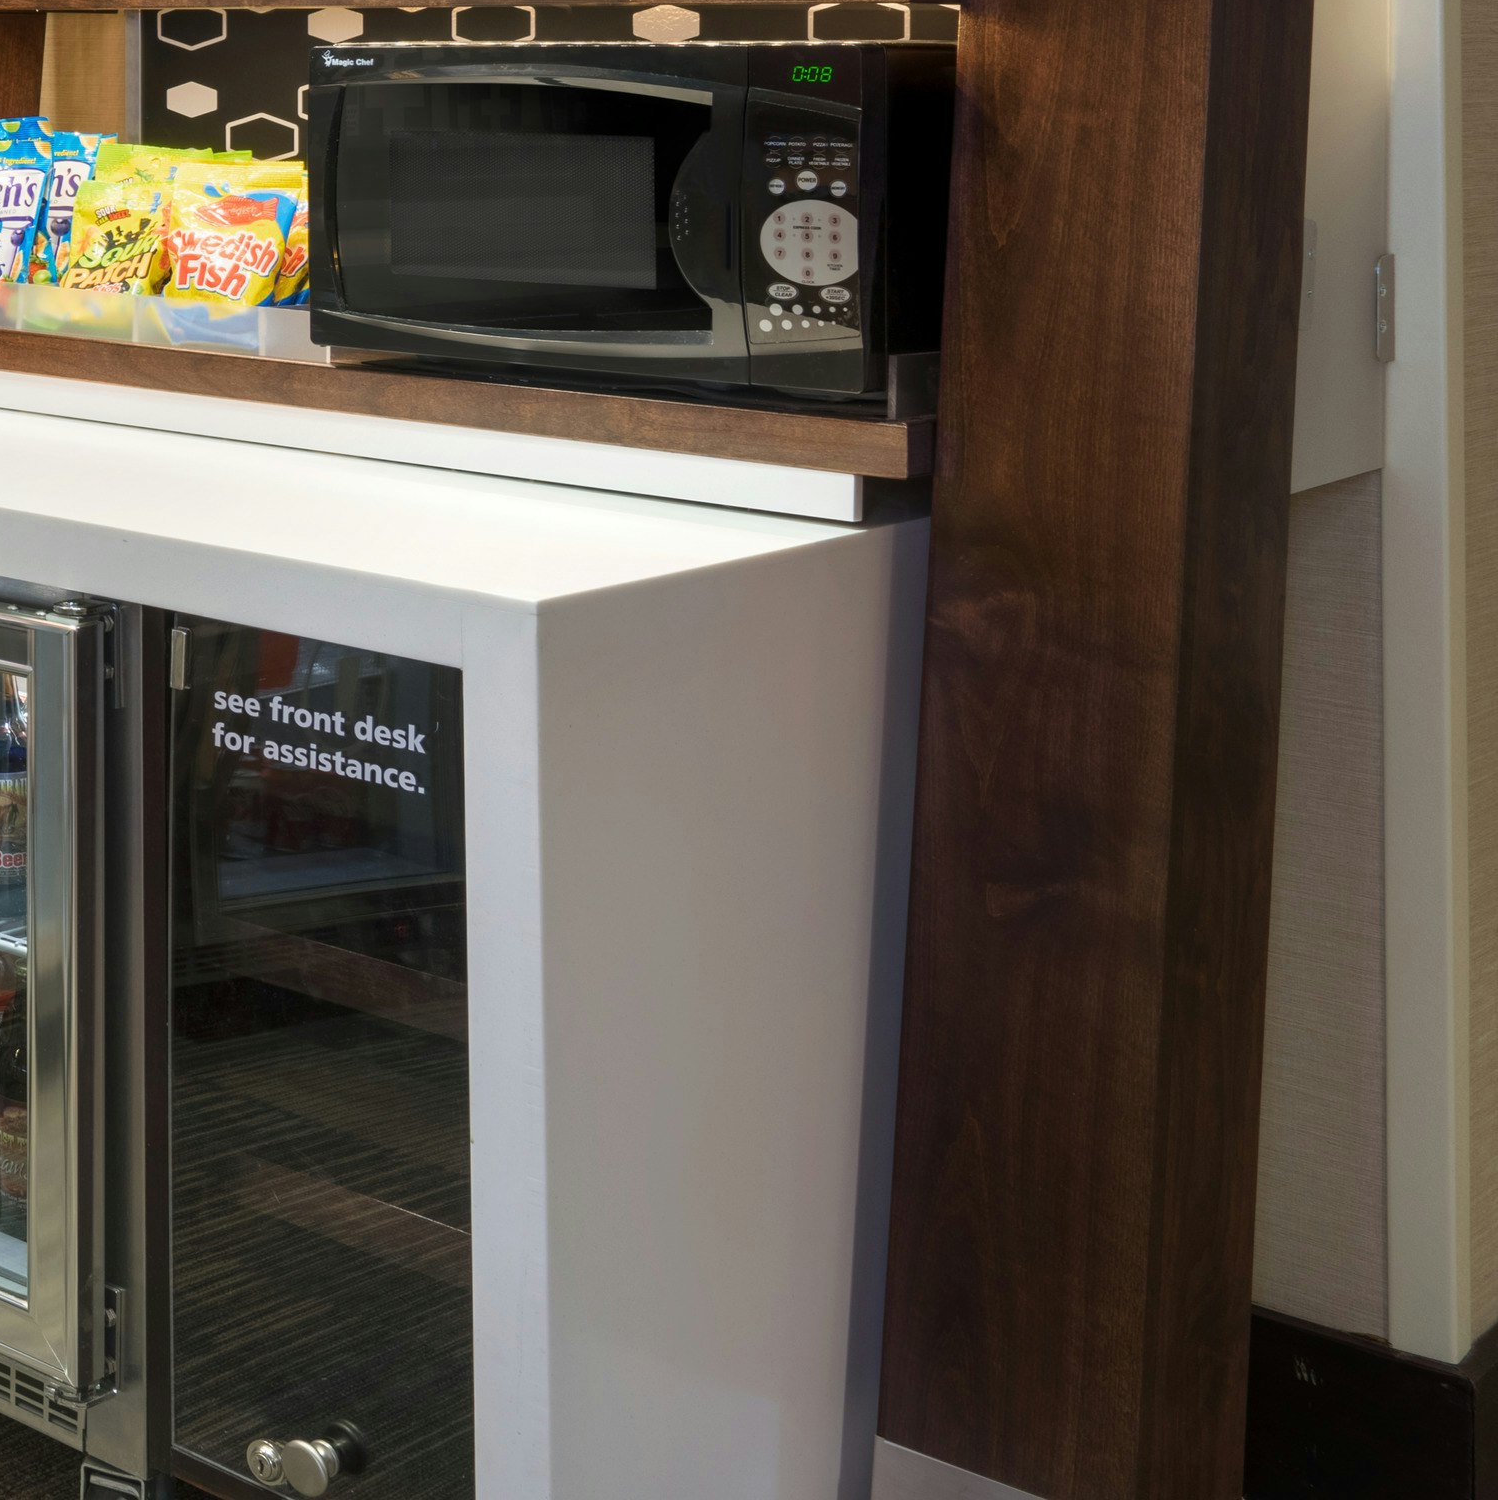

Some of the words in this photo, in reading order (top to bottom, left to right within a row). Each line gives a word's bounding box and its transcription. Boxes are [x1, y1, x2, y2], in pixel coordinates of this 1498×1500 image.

[332, 58, 354, 68] Magic
[356, 57, 374, 67] Chef
[792, 65, 833, 83] 0:08
[79, 232, 166, 267] SOUR
[169, 230, 280, 276] Swedish
[62, 253, 155, 290] PATCH
[176, 254, 247, 299] Fish
[214, 691, 260, 717] see
[269, 697, 344, 736] front
[354, 716, 426, 754] desk
[212, 722, 255, 754] for
[263, 740, 425, 794] assistance.
